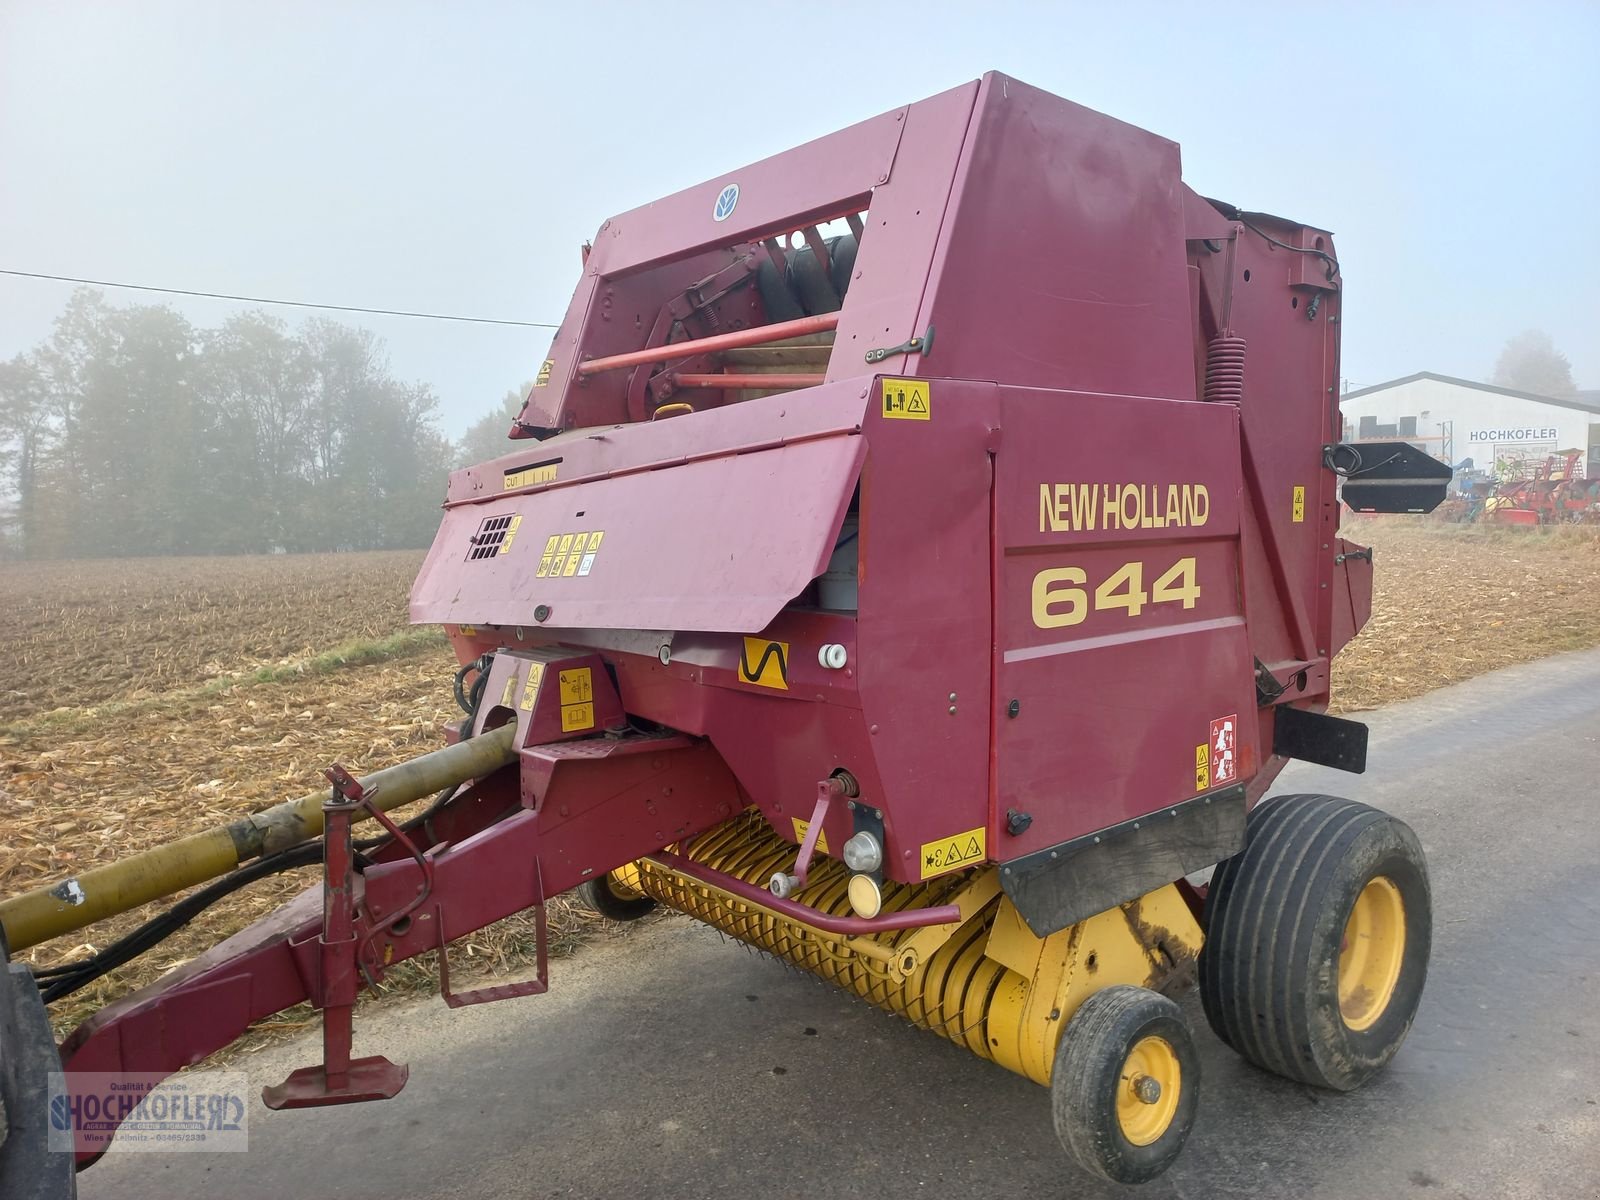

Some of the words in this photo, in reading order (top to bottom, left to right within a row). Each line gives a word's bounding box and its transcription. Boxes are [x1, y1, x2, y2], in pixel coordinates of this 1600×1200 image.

[1470, 428, 1557, 441] HOCHKOFLER
[1039, 483, 1098, 532] NEW
[1102, 483, 1210, 530] HOLLAND
[1031, 557, 1201, 629] 644
